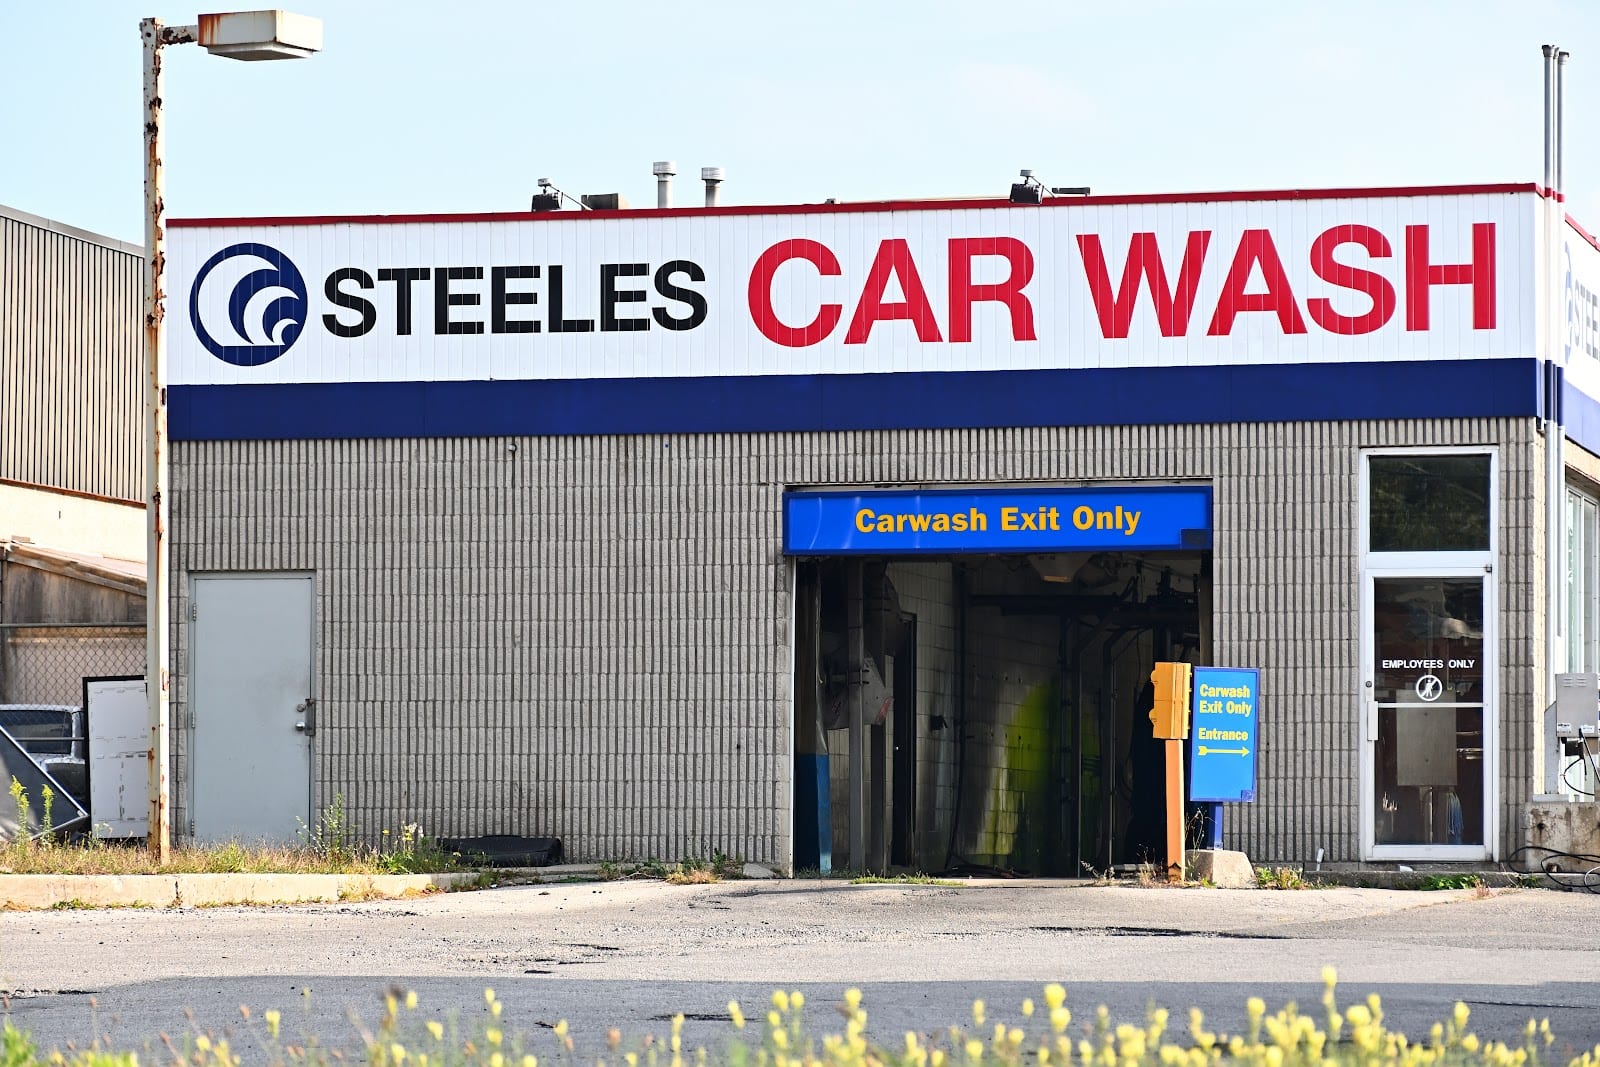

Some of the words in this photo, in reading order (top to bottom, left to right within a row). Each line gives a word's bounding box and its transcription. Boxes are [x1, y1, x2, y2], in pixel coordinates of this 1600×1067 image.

[322, 259, 708, 338] STEELES
[748, 236, 1037, 348] CAR
[1076, 222, 1495, 341] WASH
[1574, 278, 1600, 362] STEE
[855, 507, 987, 534] Carwash
[1001, 506, 1060, 532] Exit
[1073, 505, 1141, 536] Only
[1382, 658, 1444, 669] EMPLOYEES
[1448, 658, 1475, 669] ONLY
[1199, 683, 1251, 699] Carwash
[1199, 700, 1223, 715] Exit
[1226, 701, 1252, 718] Only
[1198, 727, 1249, 741] Entrance
